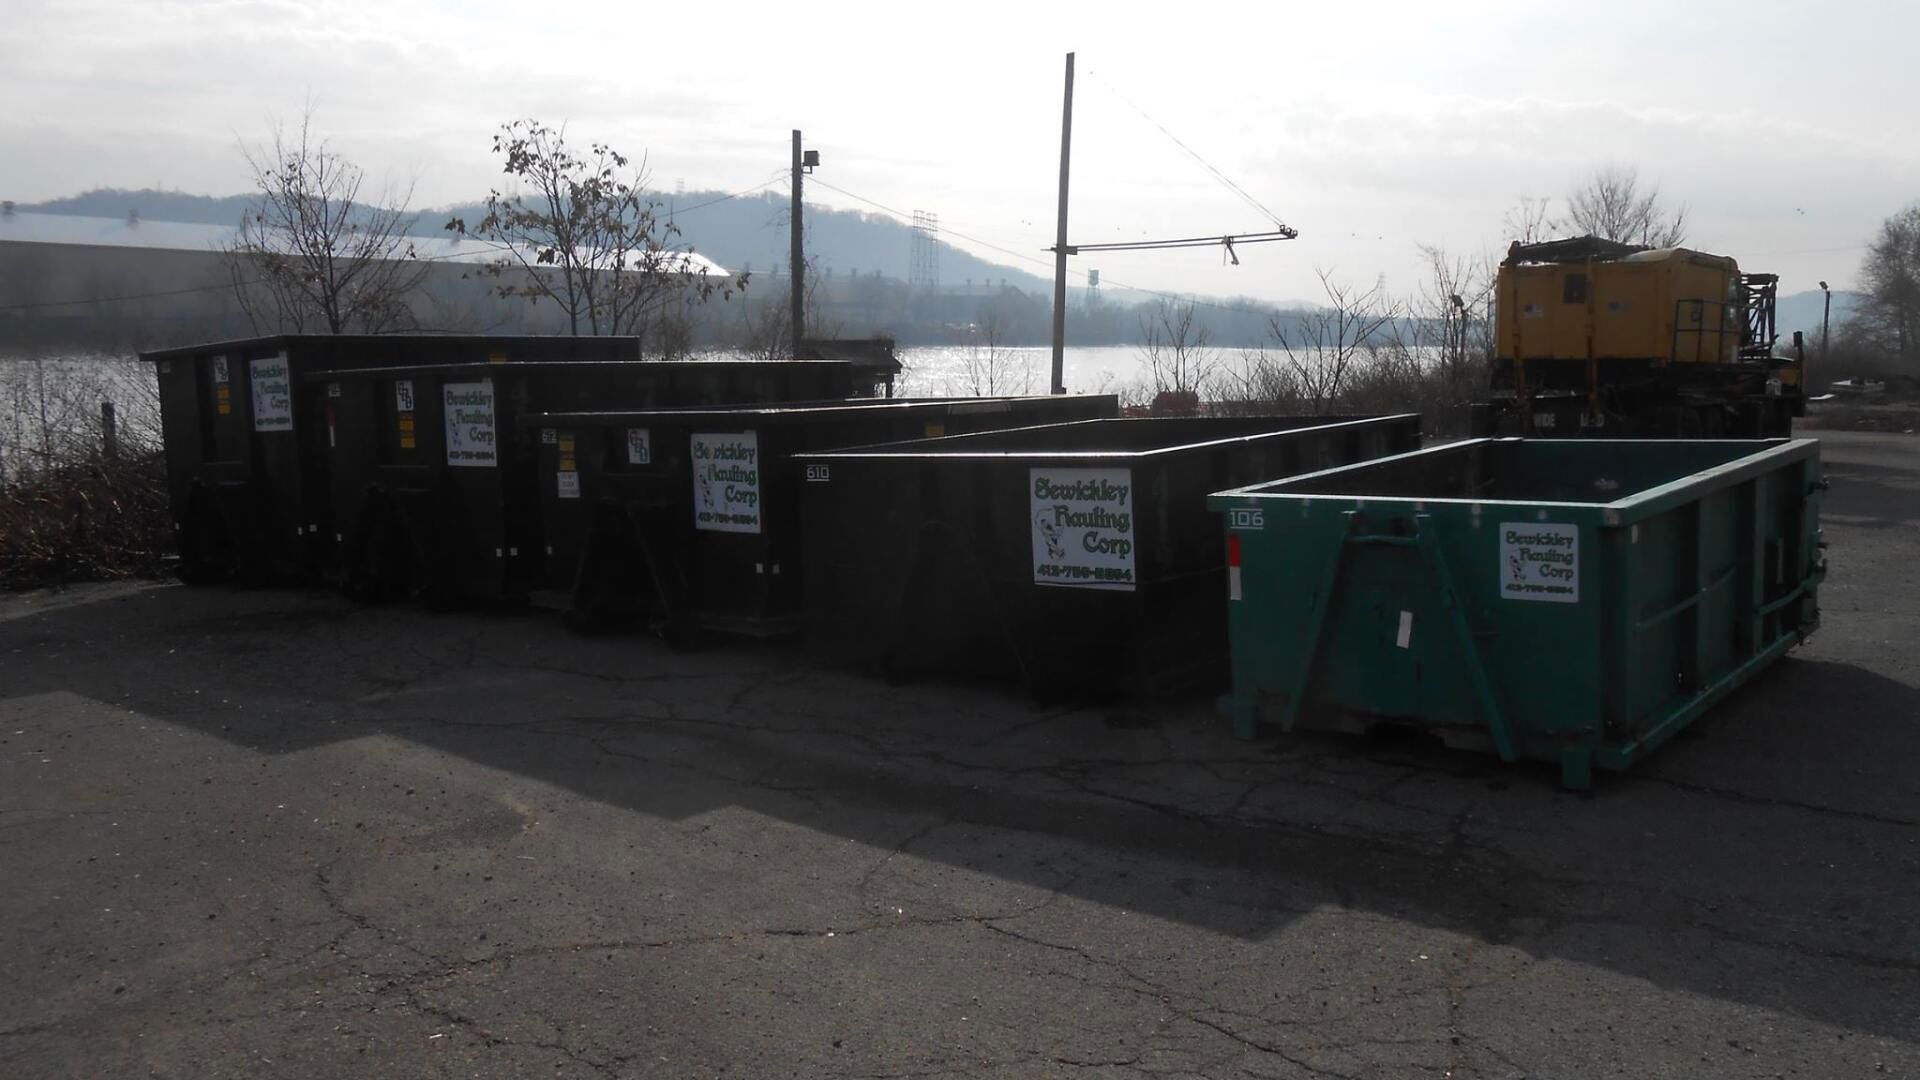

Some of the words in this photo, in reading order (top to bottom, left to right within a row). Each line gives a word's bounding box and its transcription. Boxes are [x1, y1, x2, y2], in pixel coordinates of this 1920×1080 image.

[1533, 412, 1556, 427] WIDE
[1580, 412, 1604, 427] LD
[469, 426, 494, 445] Corp
[695, 441, 755, 464] Sewickley
[707, 464, 757, 485] Hauling
[806, 466, 830, 480] 610
[725, 484, 757, 507] Corp
[1035, 477, 1128, 506] Sewickley
[1053, 505, 1130, 533] Hauling
[1230, 511, 1264, 526] 106
[1083, 531, 1131, 560] Corp
[1505, 530, 1573, 548] Sewickley
[1519, 547, 1574, 565] Hauling
[1539, 564, 1573, 581] Corp
